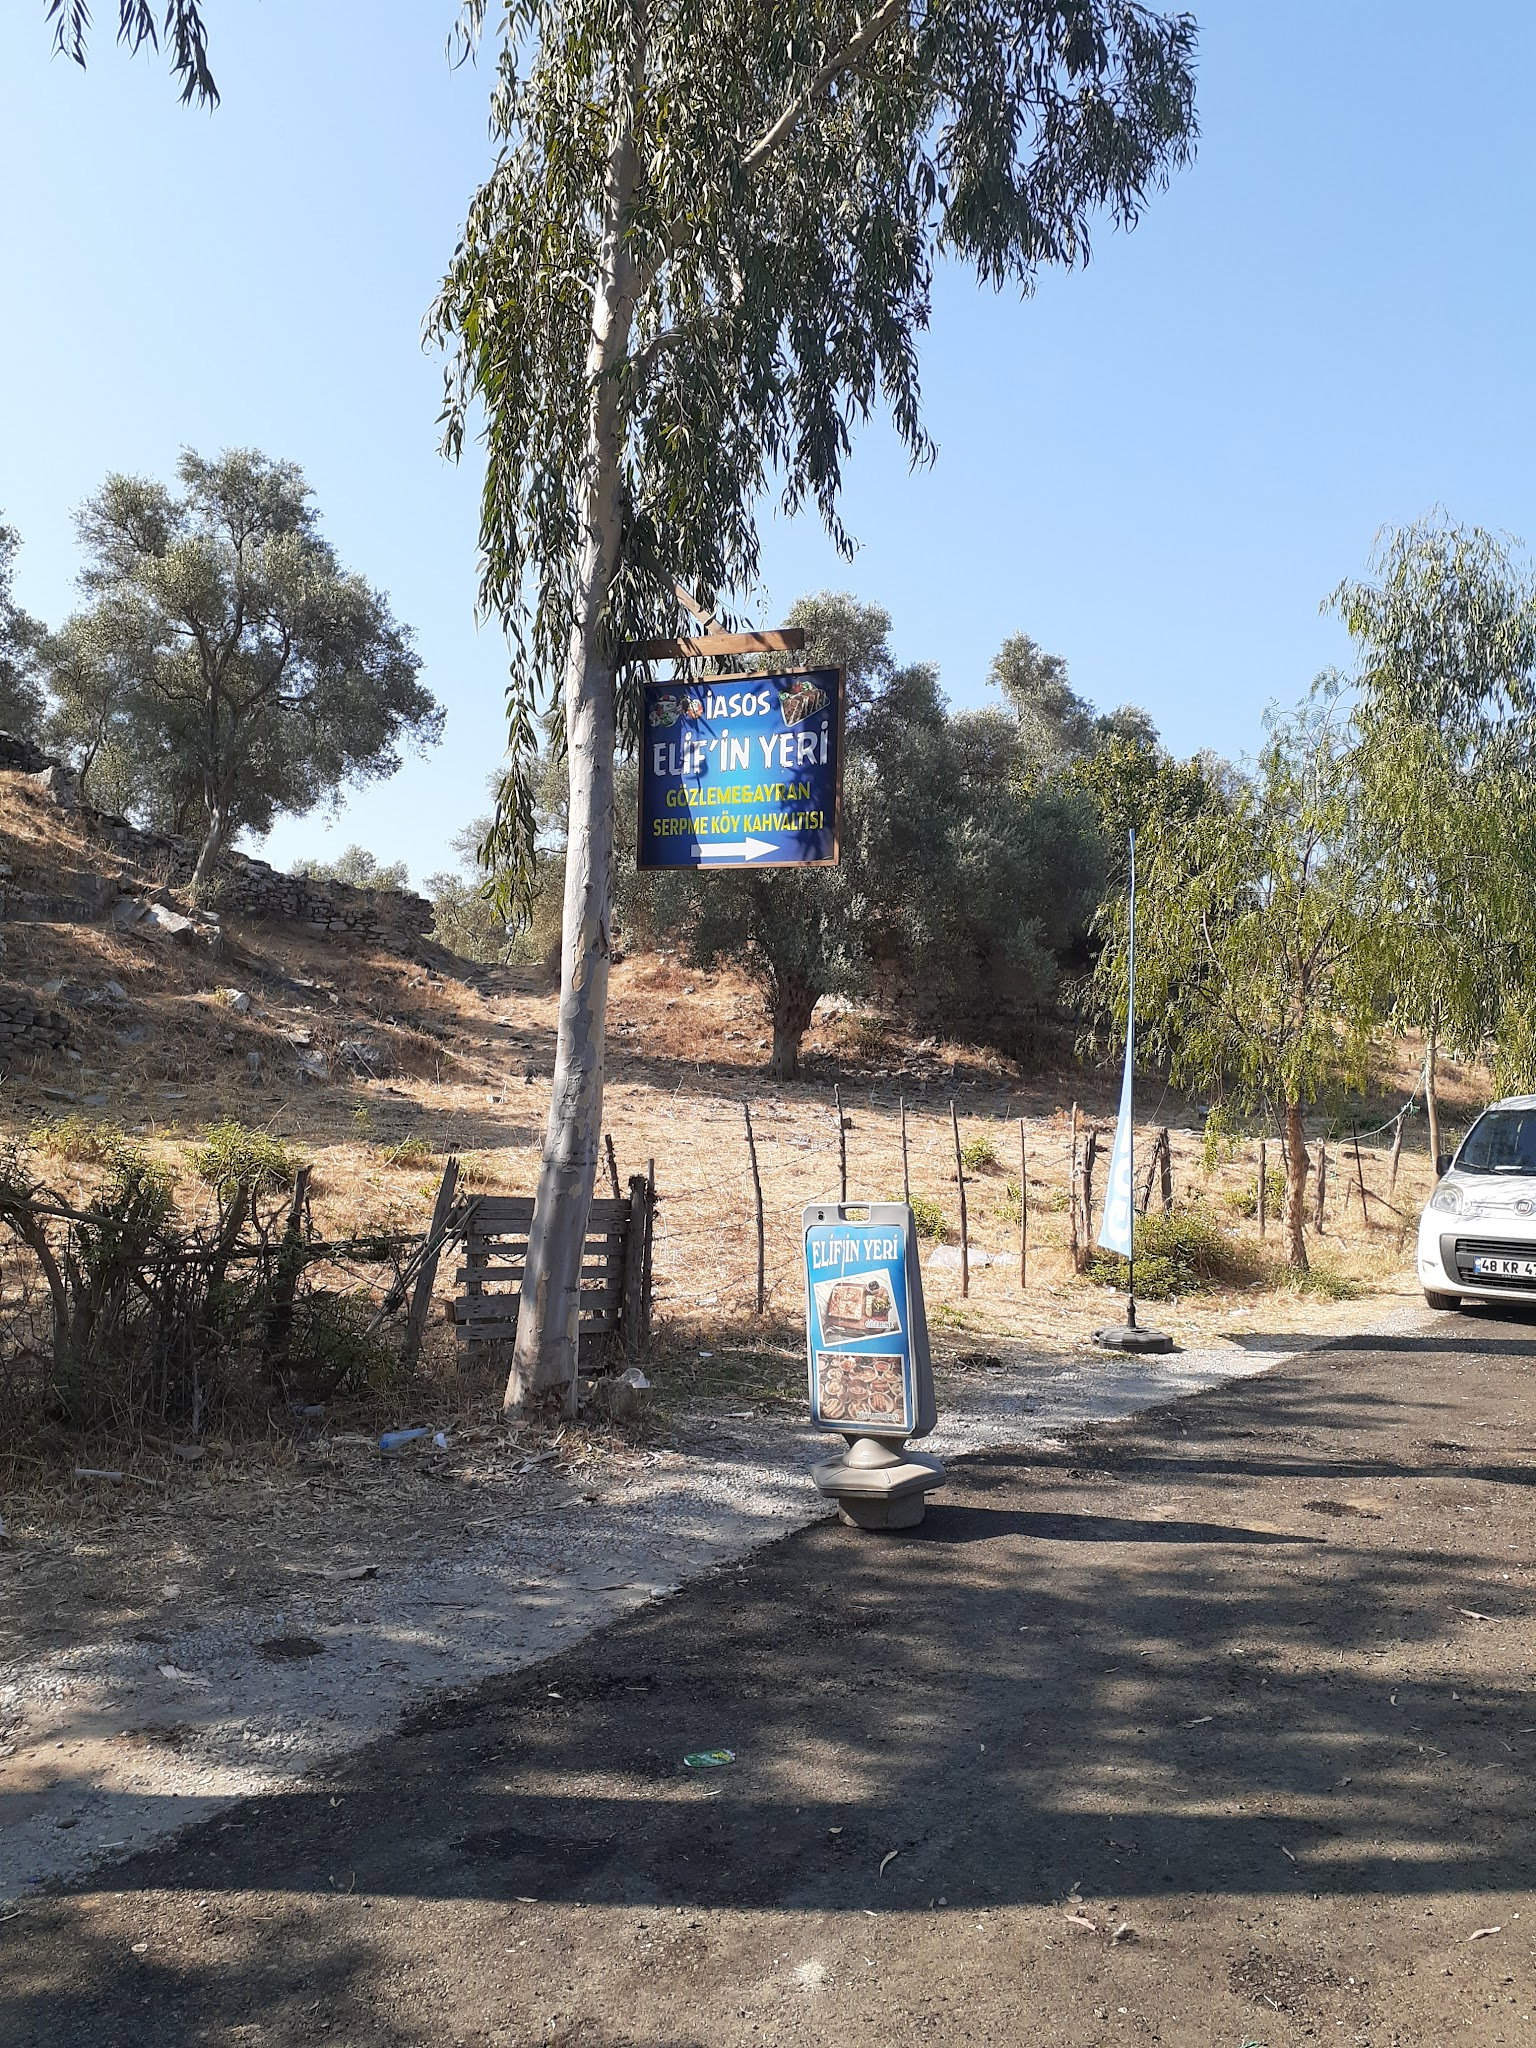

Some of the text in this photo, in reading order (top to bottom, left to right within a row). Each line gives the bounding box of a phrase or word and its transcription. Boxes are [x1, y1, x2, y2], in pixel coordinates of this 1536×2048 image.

[706, 690, 771, 720] İASOS
[653, 720, 829, 776] ELİF'İN YERİ
[653, 810, 824, 836] SERPME KÖY KAHVALTISI
[863, 1233, 899, 1260] YERİ
[1482, 1260, 1497, 1272] 48
[1503, 1261, 1519, 1274] KR
